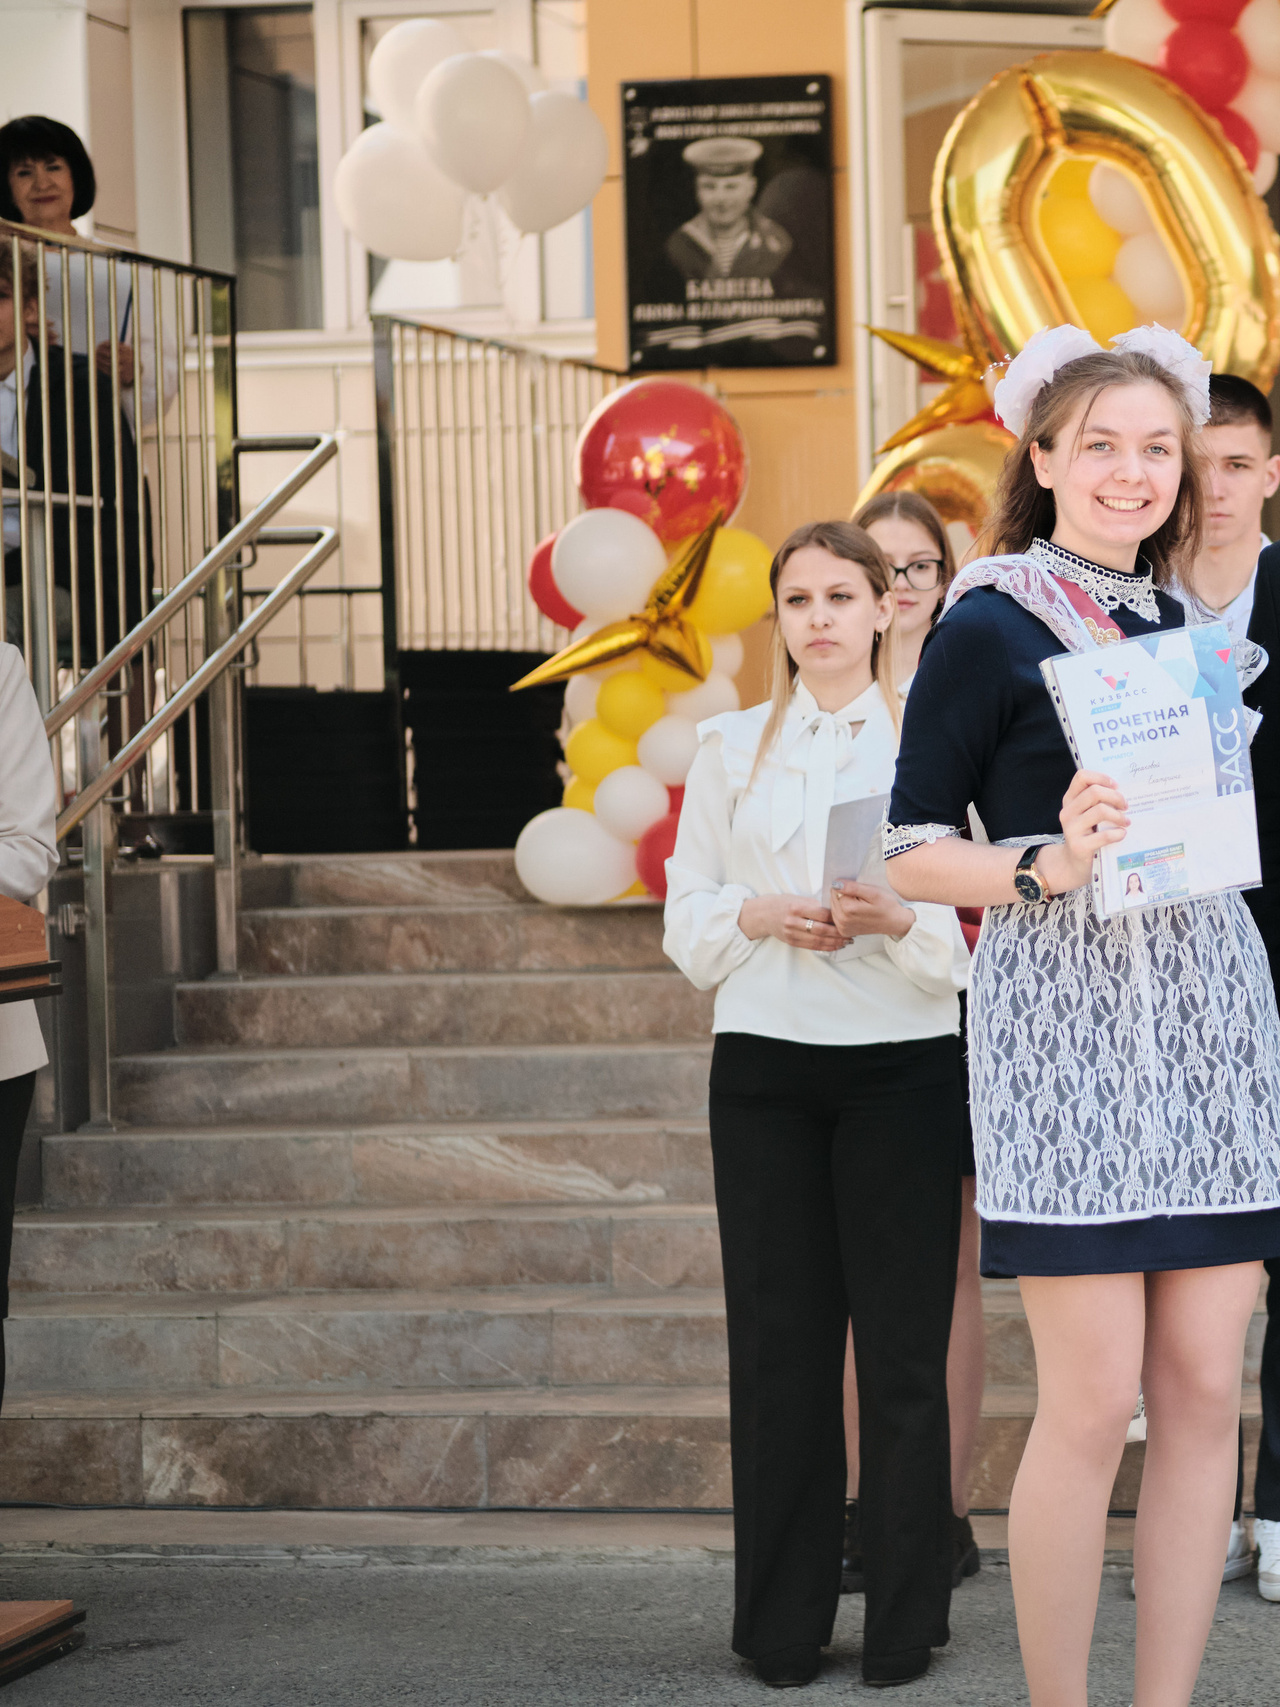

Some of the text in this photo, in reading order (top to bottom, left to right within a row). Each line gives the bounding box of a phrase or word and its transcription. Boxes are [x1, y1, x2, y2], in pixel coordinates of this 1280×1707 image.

[1090, 687, 1148, 706] КУЗБАСС
[1093, 704, 1189, 734] ПОЧЕТНАЯ
[1097, 724, 1180, 751] ГРАМОТА
